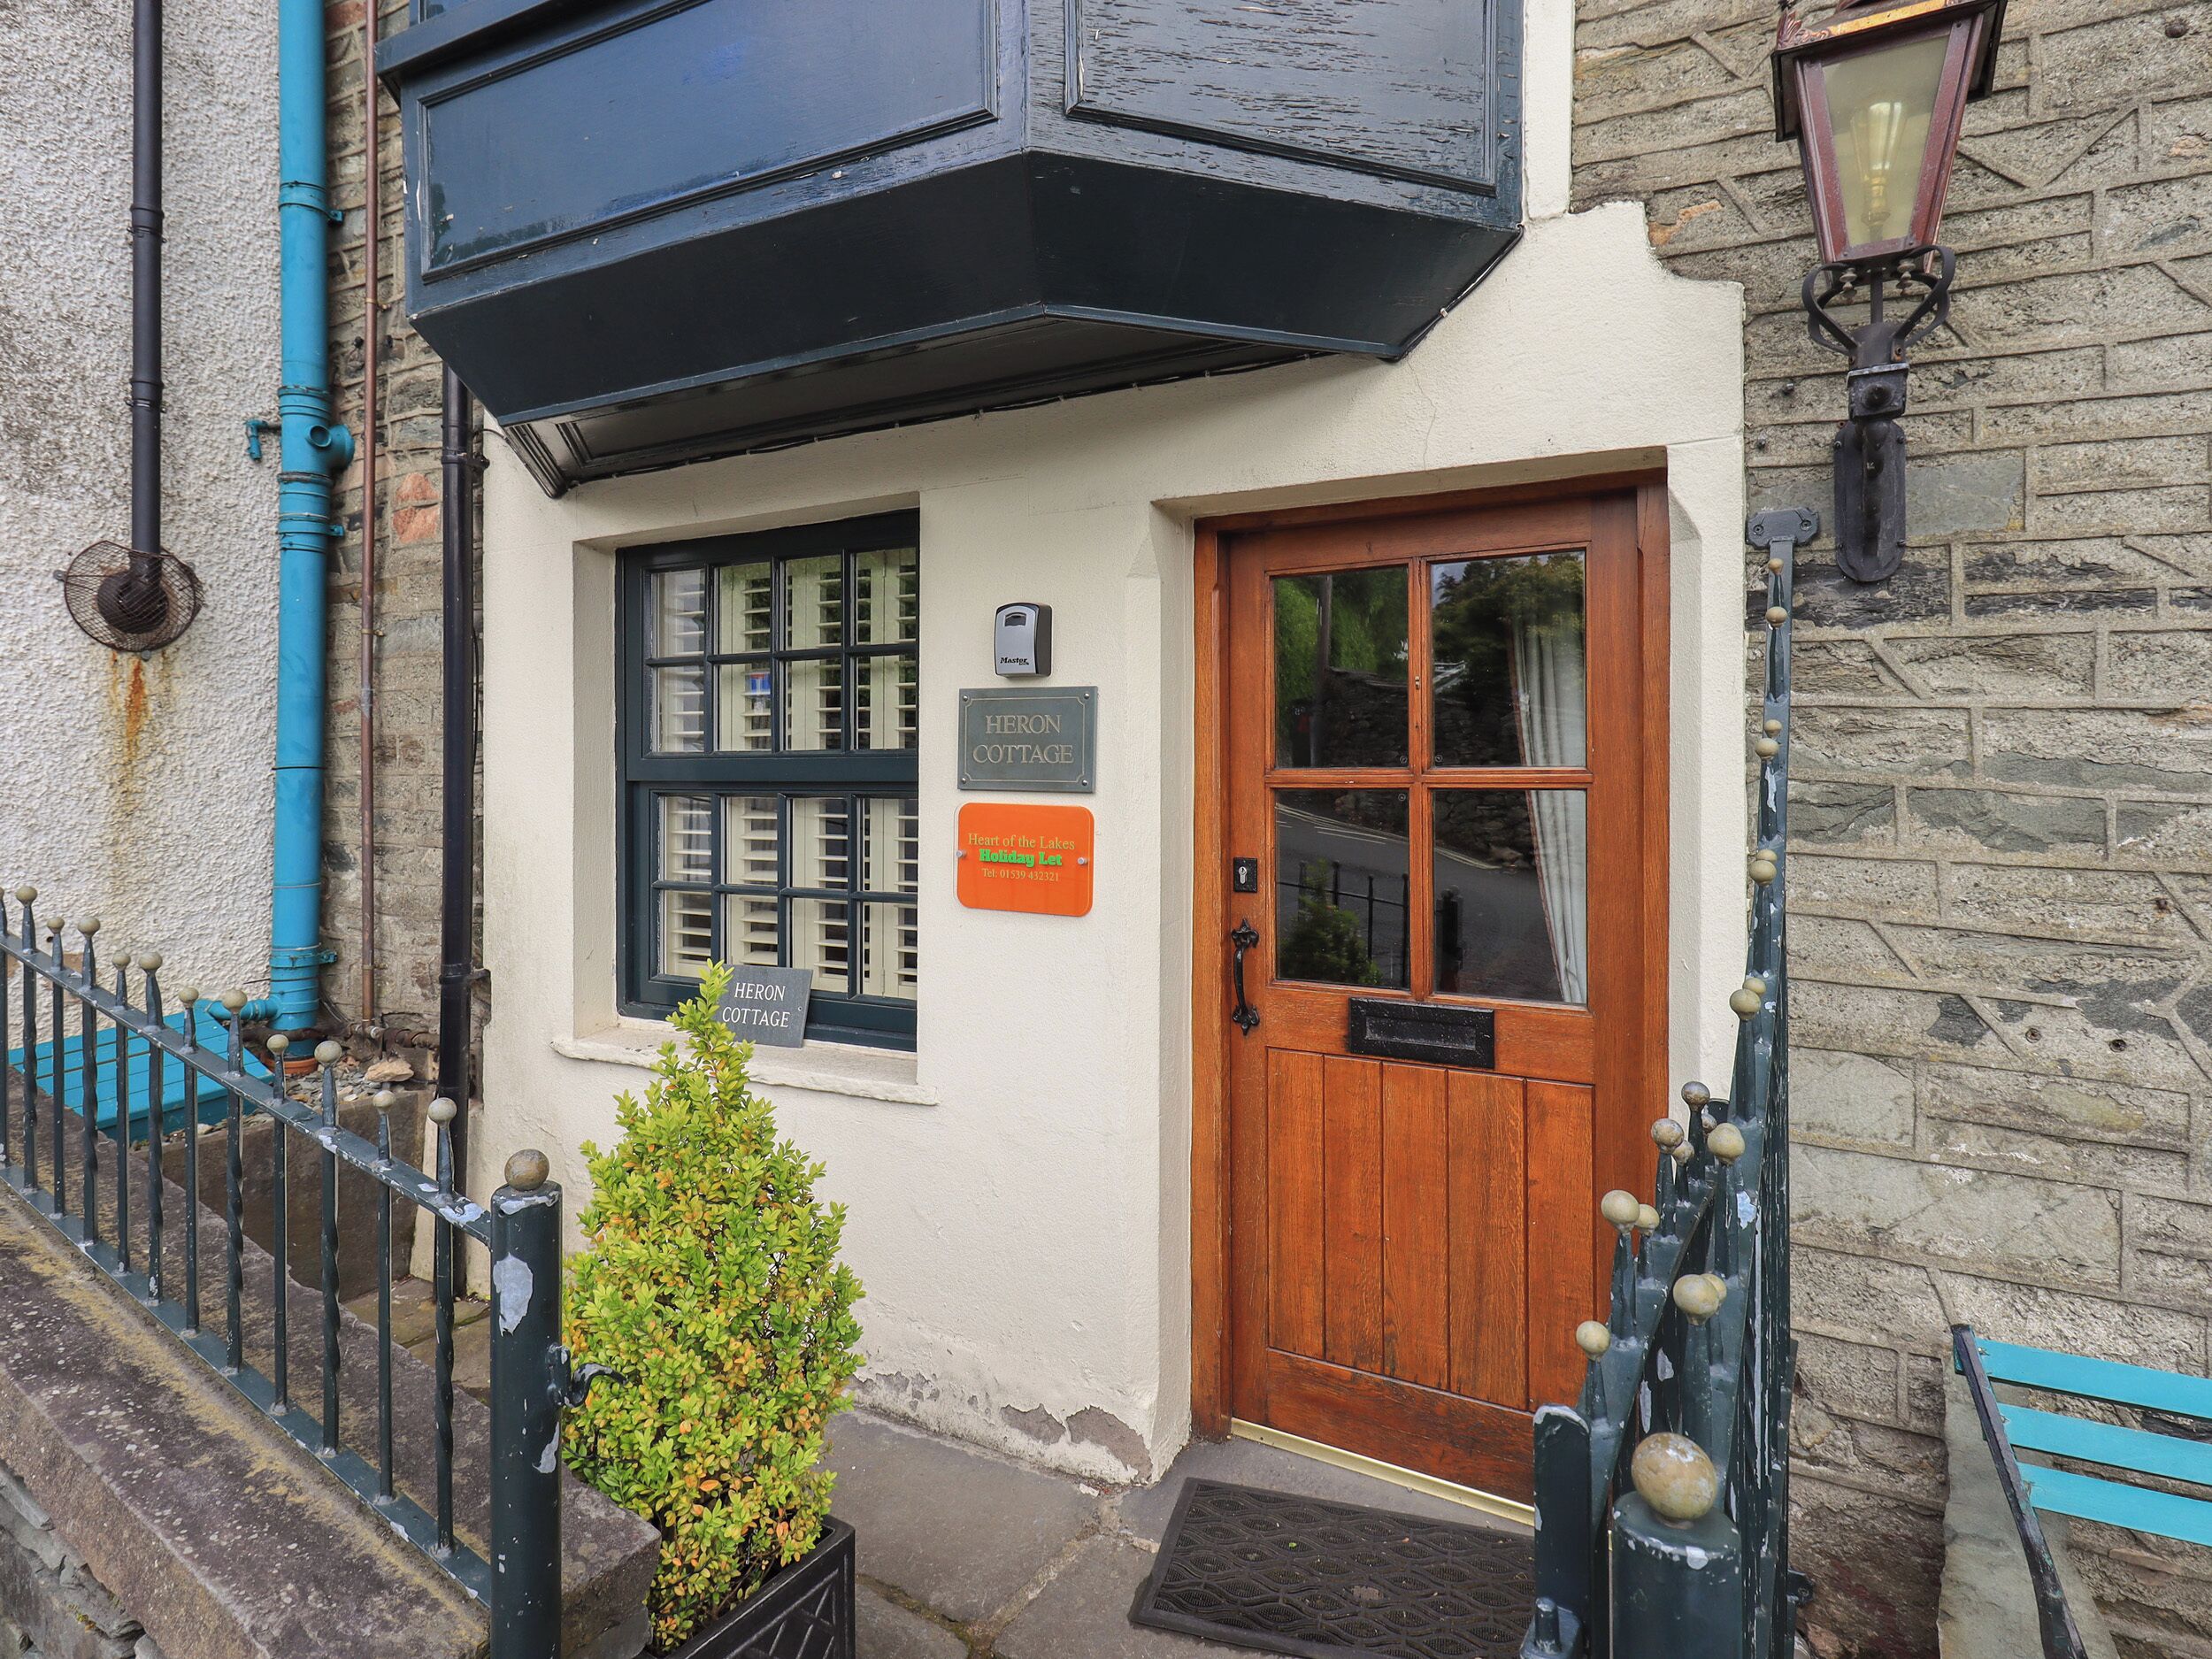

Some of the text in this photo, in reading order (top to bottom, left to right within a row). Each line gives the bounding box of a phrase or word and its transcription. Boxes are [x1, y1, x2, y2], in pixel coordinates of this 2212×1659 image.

[985, 714, 1062, 734] HERON
[973, 744, 1075, 764] COTTAGE
[968, 833, 1075, 850] Heart of the Lakes
[979, 849, 1063, 867] Holiday Let
[1000, 870, 1026, 879] 01539
[1028, 871, 1059, 882] 432321
[733, 982, 787, 1002] HERON
[722, 1006, 791, 1028] COTTAGE
